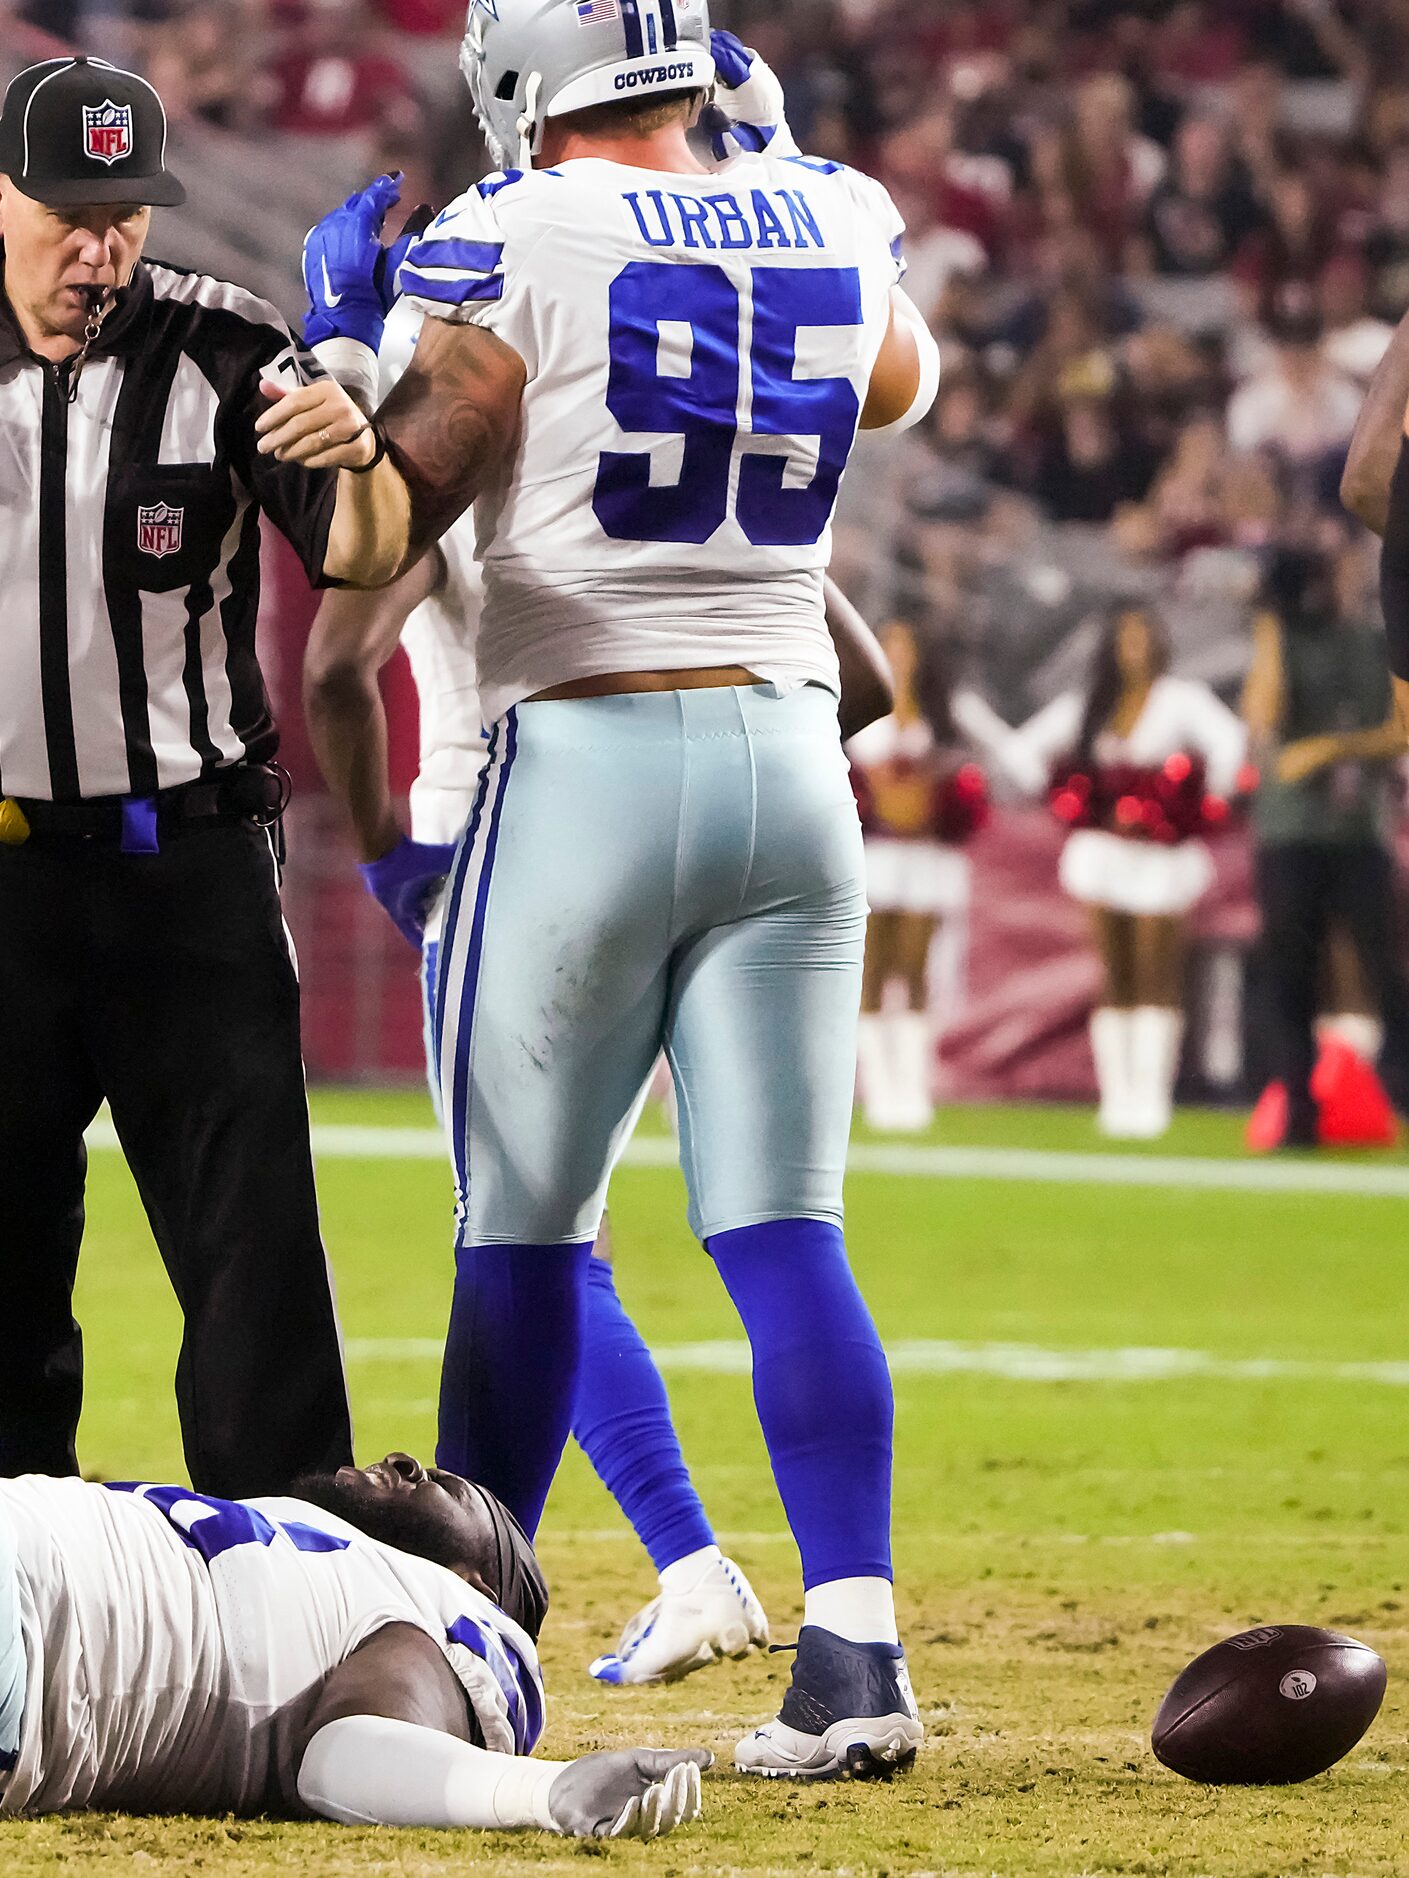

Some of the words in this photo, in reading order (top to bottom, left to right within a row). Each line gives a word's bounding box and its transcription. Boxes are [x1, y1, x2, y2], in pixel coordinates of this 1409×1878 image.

[614, 62, 694, 90] COWBOYS
[90, 128, 127, 156] NFL
[621, 189, 825, 249] URBAN
[592, 261, 864, 546] 95
[142, 526, 178, 552] NFL
[1292, 1682, 1310, 1698] 102
